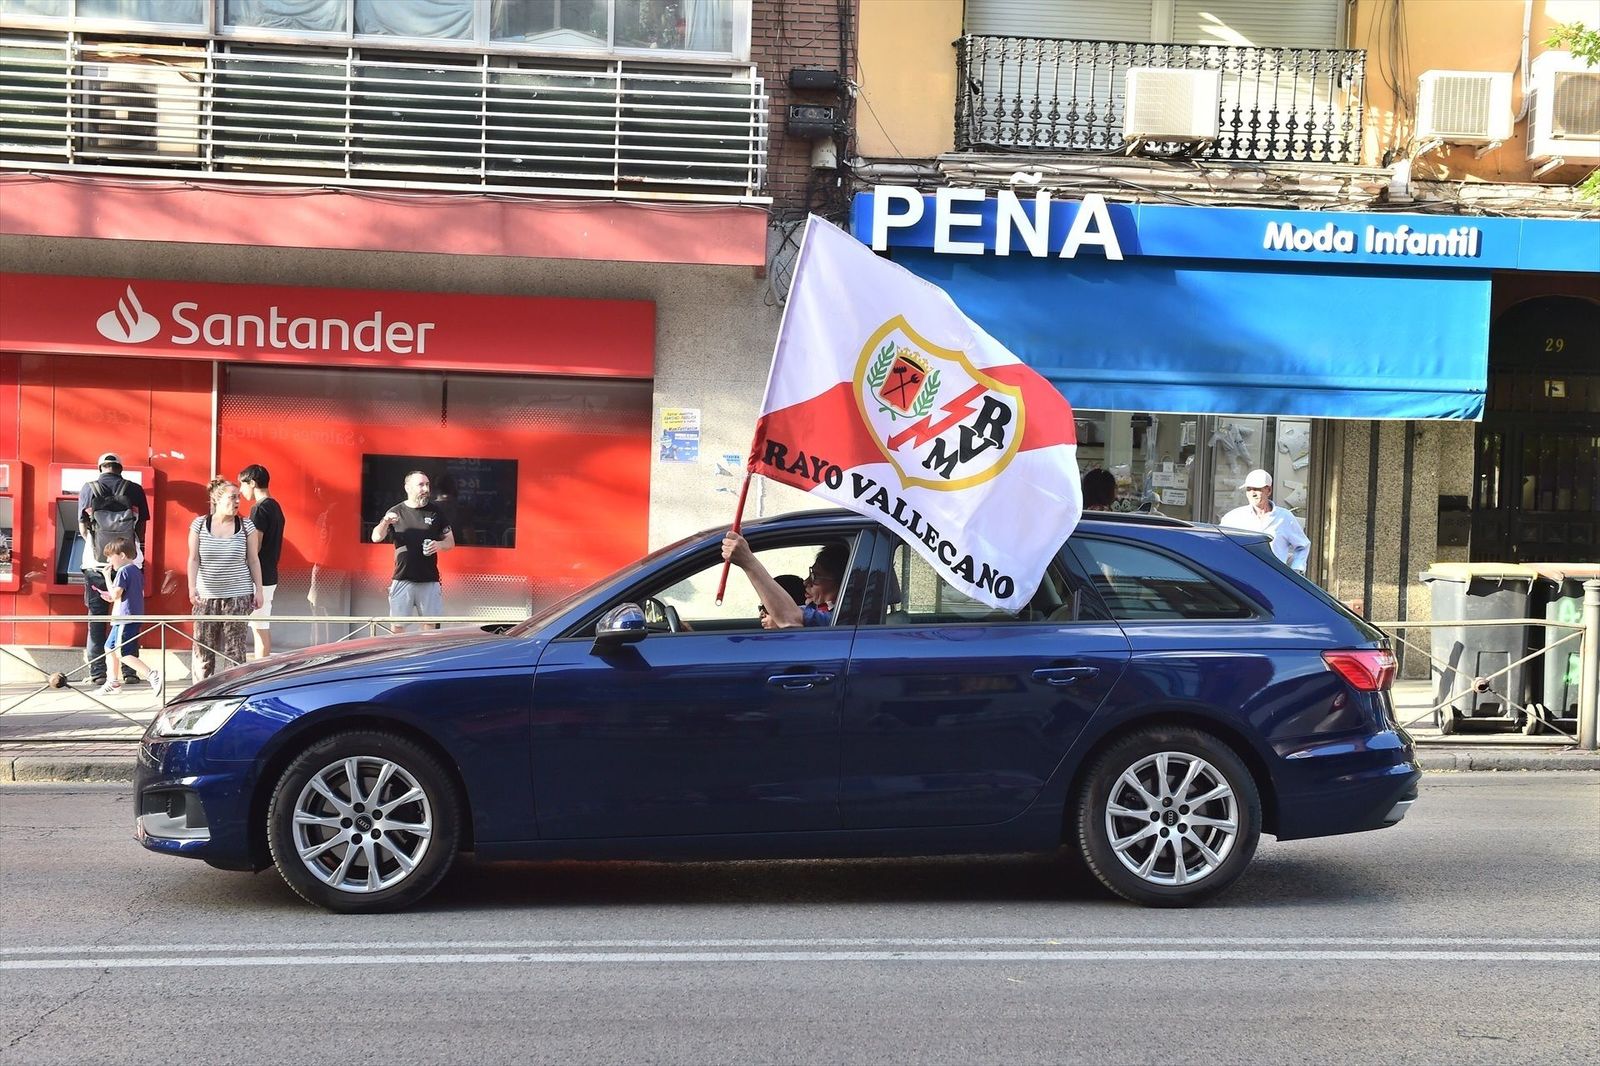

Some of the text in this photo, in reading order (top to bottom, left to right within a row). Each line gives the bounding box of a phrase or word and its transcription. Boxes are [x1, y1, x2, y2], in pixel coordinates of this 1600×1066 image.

[871, 171, 1124, 261] PEÑA
[1263, 221, 1481, 258] Moda Infantil
[170, 300, 436, 354] Santander
[1544, 338, 1565, 353] 29
[761, 440, 1015, 599] RAYO VALLECANO
